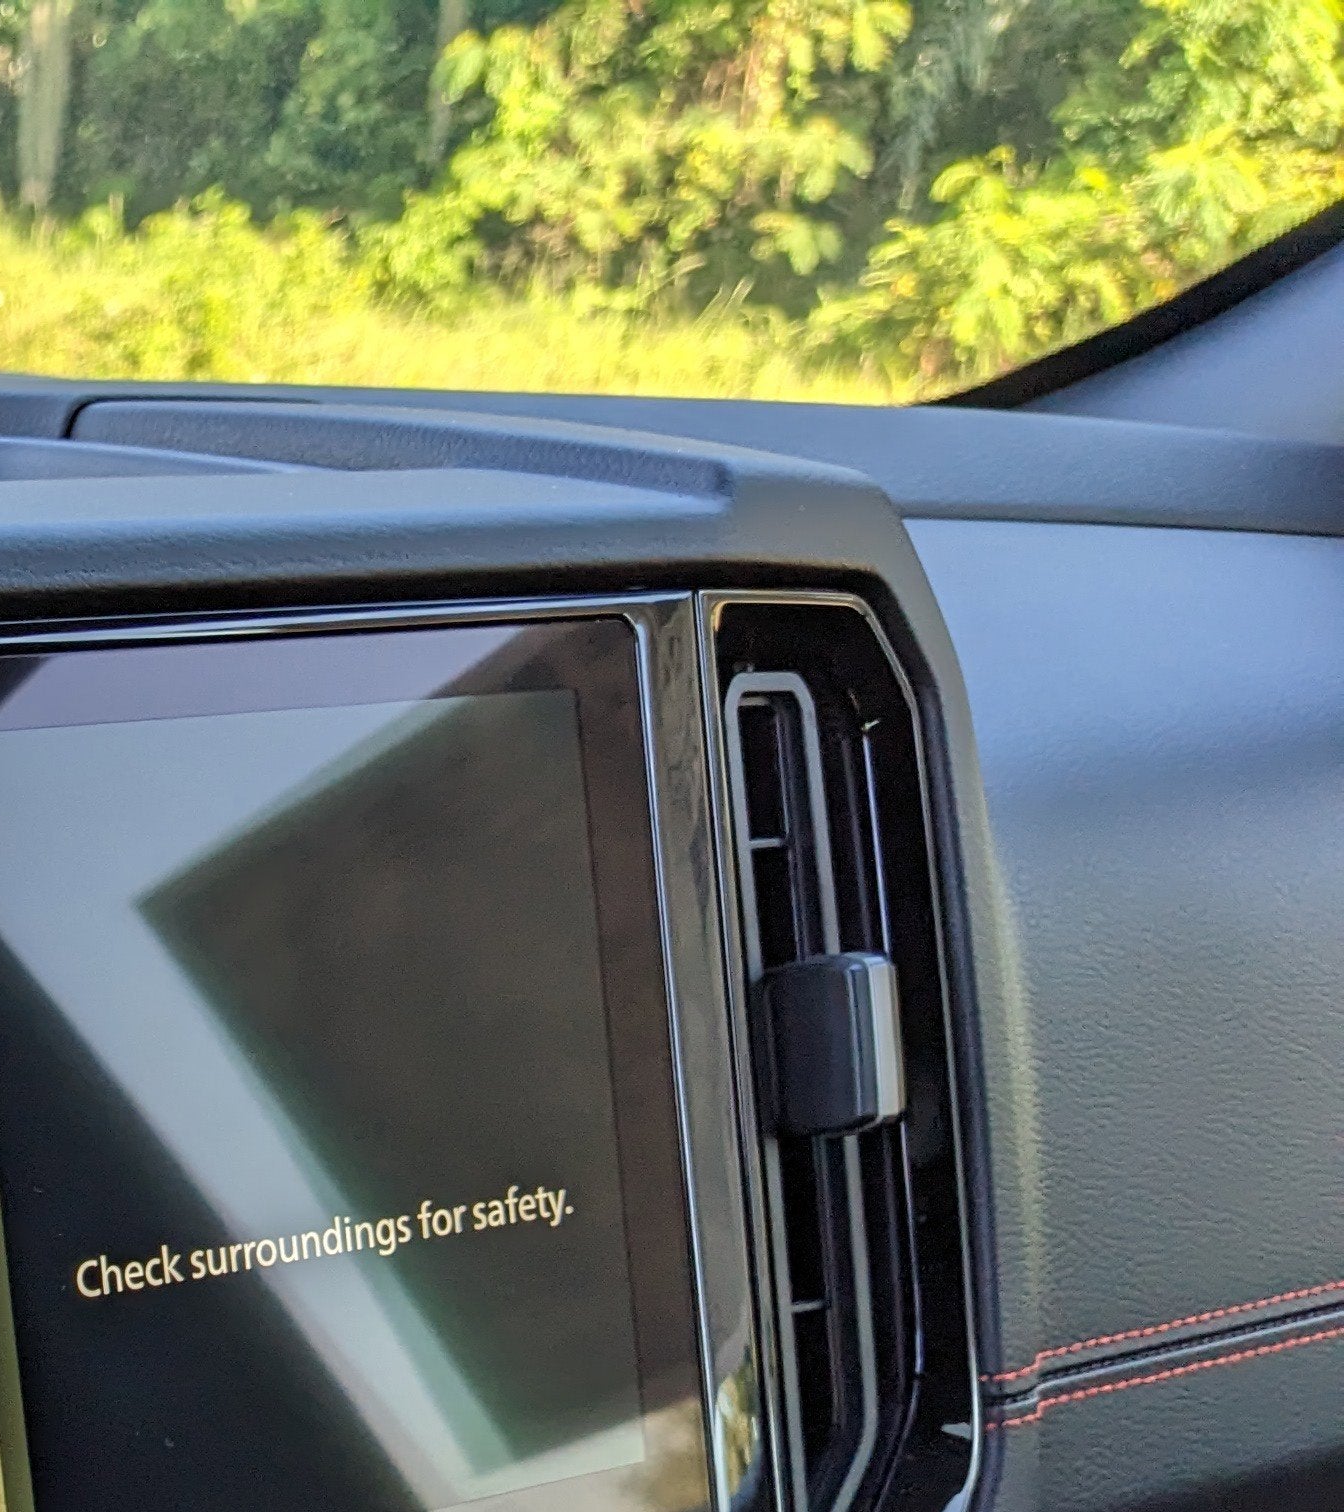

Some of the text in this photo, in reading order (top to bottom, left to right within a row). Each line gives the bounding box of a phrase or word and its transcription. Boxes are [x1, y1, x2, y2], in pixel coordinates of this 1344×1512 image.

[76, 1185, 574, 1298] Check surroundings for safety.
